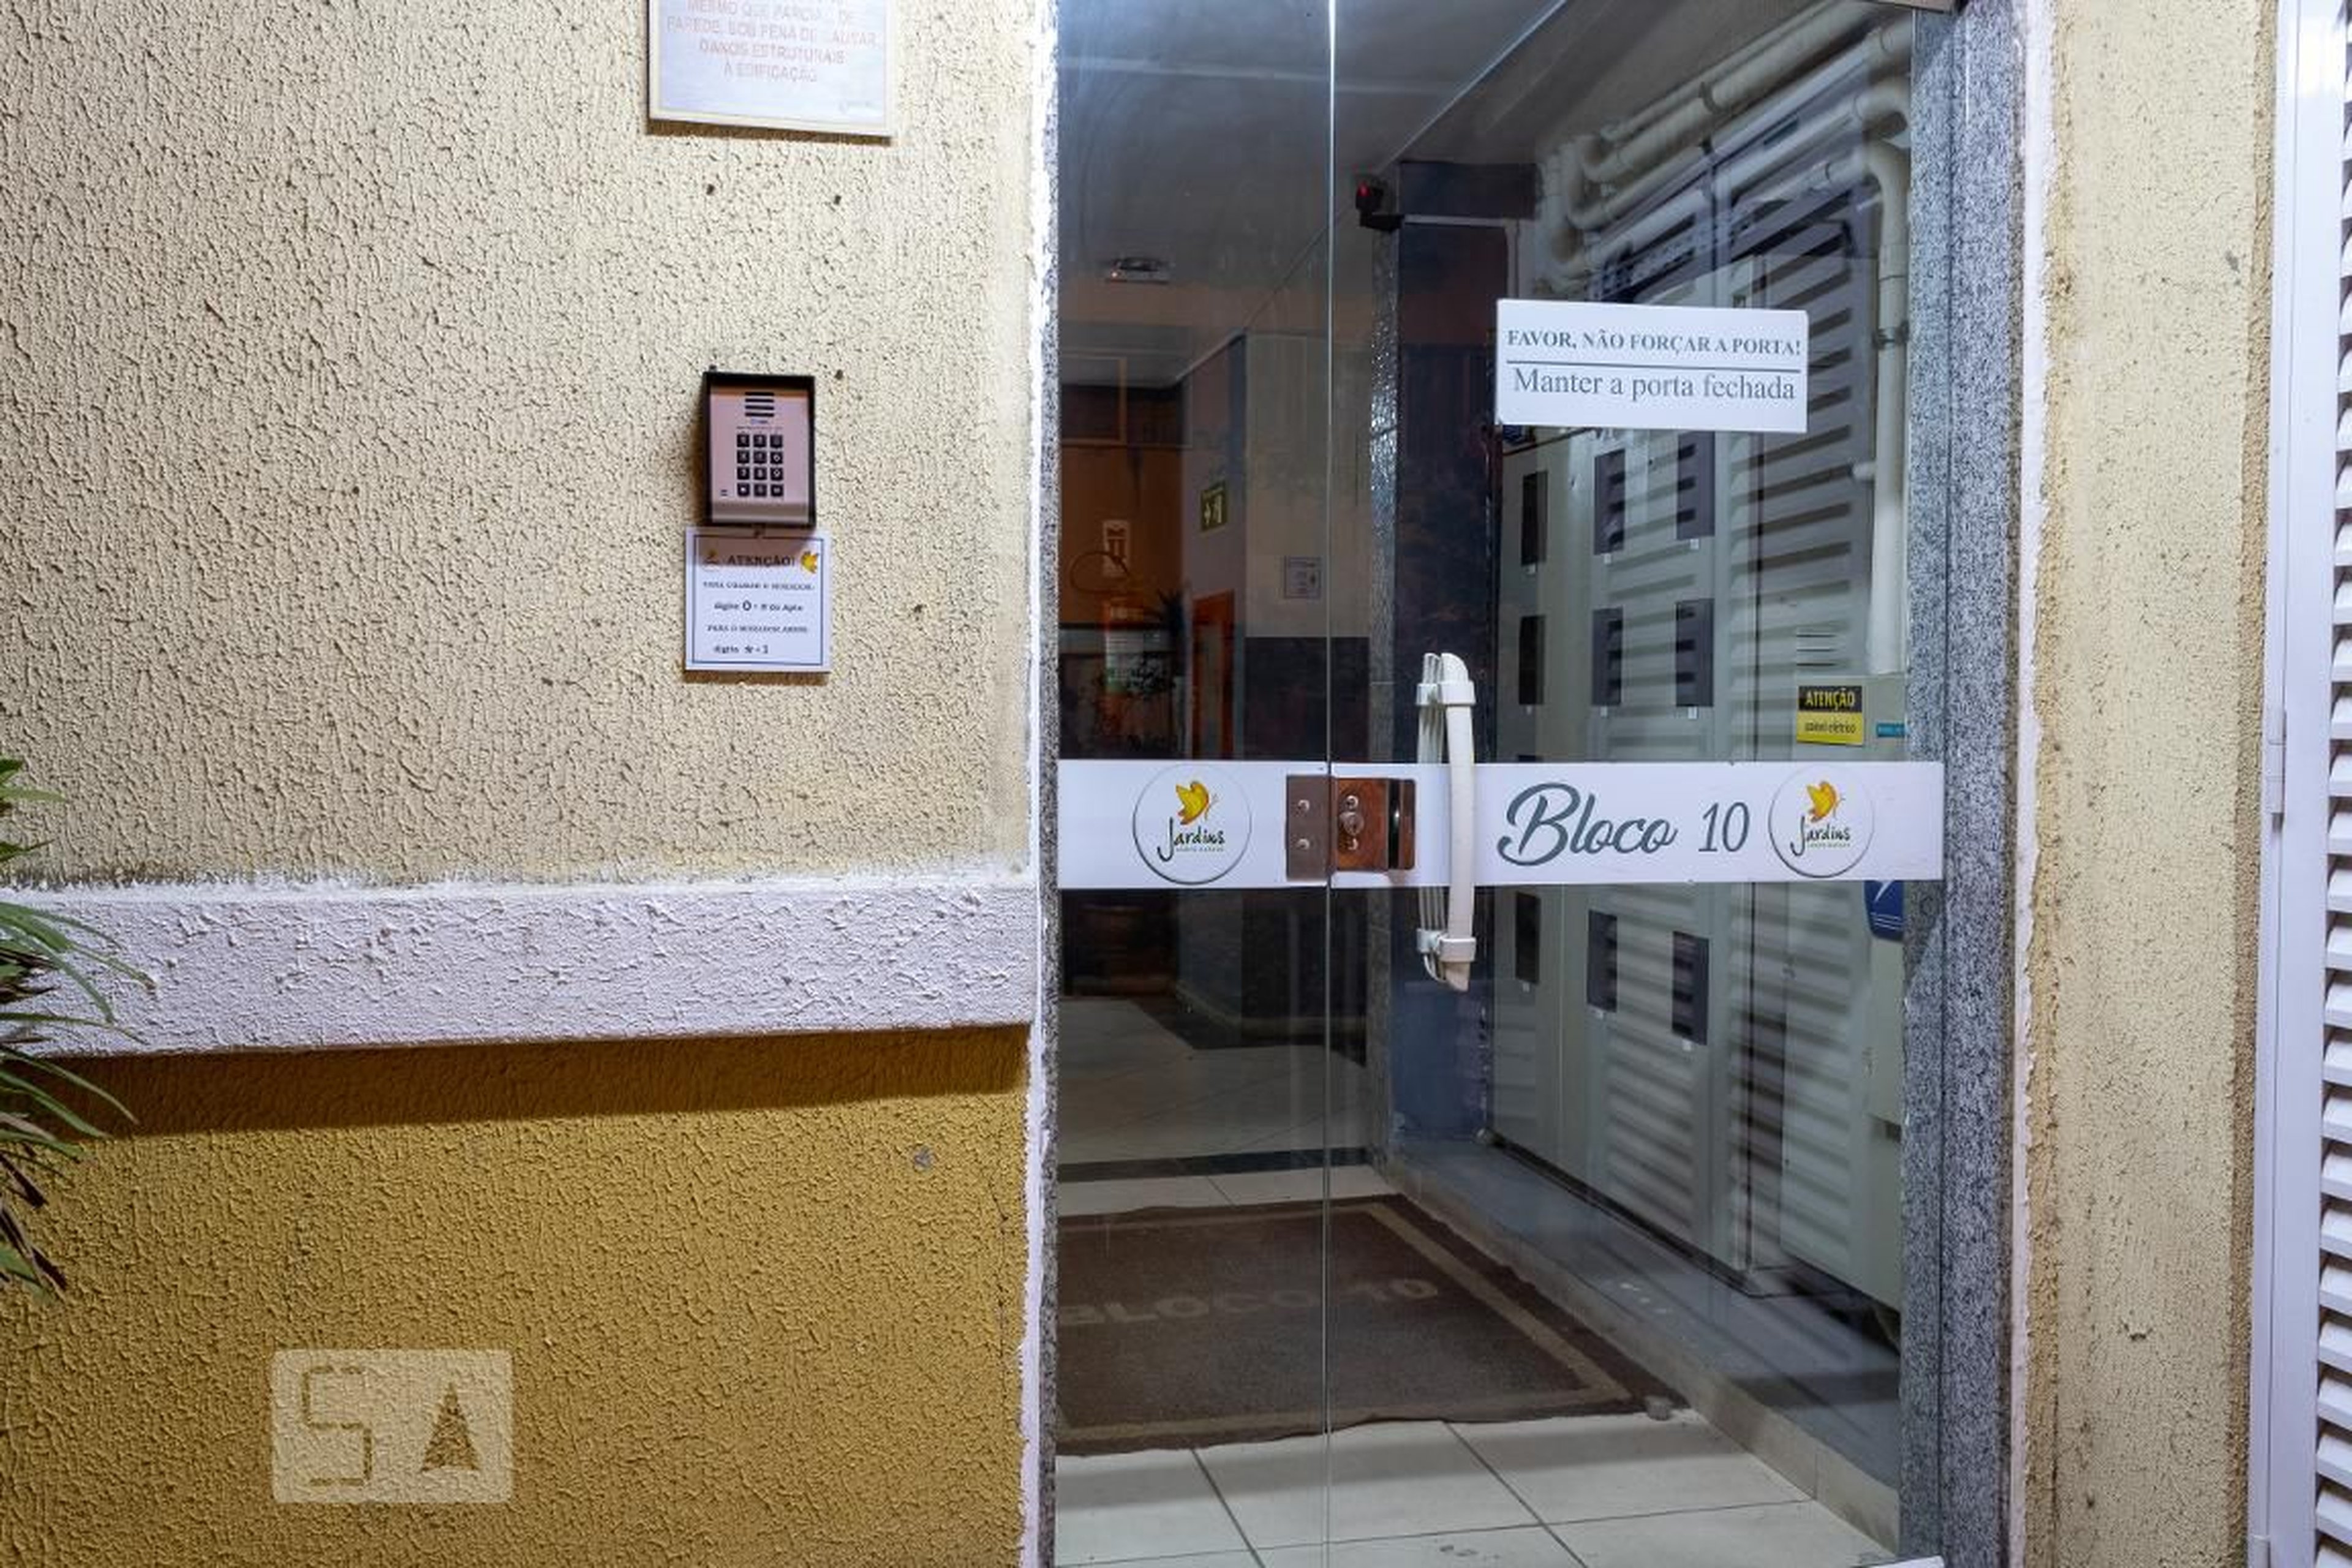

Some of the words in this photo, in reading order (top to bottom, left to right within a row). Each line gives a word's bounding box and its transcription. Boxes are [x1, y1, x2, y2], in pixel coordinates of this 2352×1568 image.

[761, 23, 797, 40] PENA
[699, 38, 748, 56] DANOS
[752, 43, 847, 64] ESTRUTURAIS
[1507, 330, 1577, 350] FAVOR,
[1583, 329, 1624, 349] NÃO
[1630, 334, 1710, 356] FORÇAR
[1713, 338, 1727, 353] A
[1732, 338, 1801, 356] PORTA!
[1513, 368, 1603, 394] Manter
[1610, 379, 1624, 395] a
[1631, 377, 1695, 402] porta
[1703, 374, 1796, 399] fechada
[728, 554, 795, 567] ATENÇÃO!
[1806, 687, 1856, 710] ATENÇÃO
[1496, 782, 1679, 867] Bloco
[1698, 801, 1751, 853] 10
[1790, 815, 1851, 857] Jardins
[1156, 816, 1226, 862] Jardins
